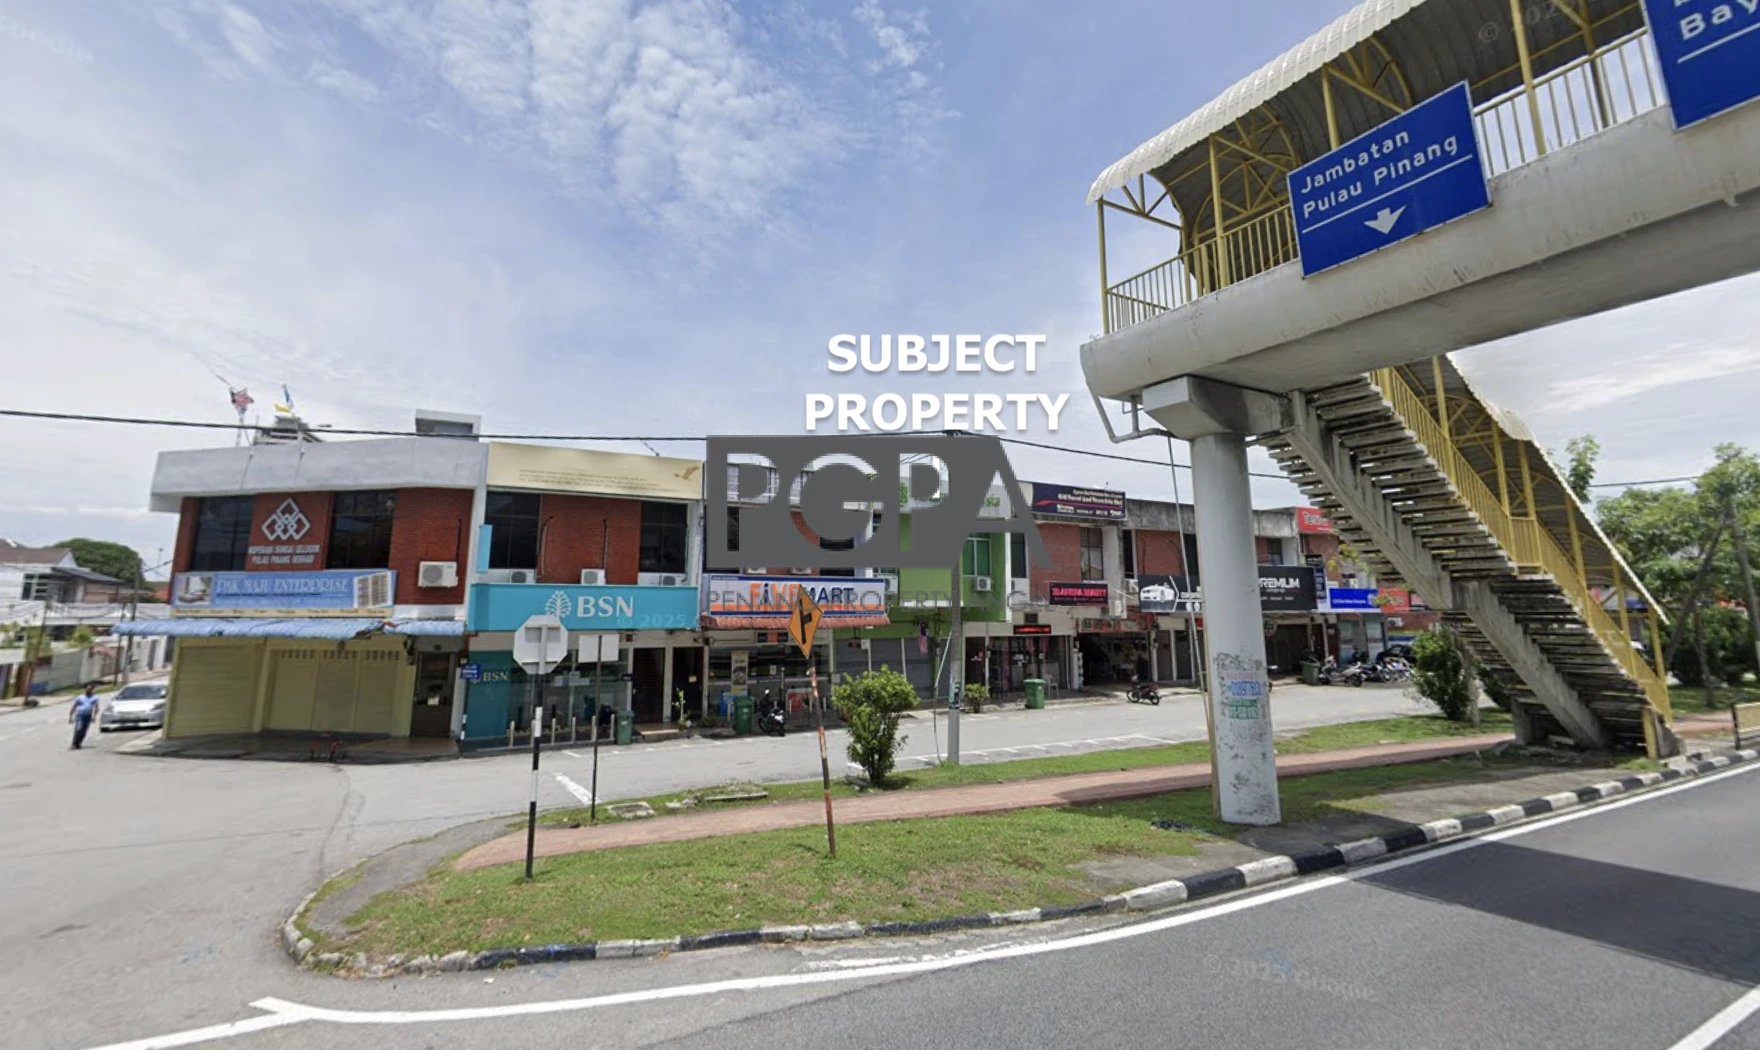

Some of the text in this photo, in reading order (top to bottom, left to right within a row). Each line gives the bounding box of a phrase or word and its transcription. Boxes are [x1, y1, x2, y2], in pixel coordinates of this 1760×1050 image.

[1300, 130, 1411, 194] Jambatan
[1302, 135, 1458, 219] Pulau Pinang
[577, 595, 635, 619] BSN
[483, 671, 509, 682] BSN
